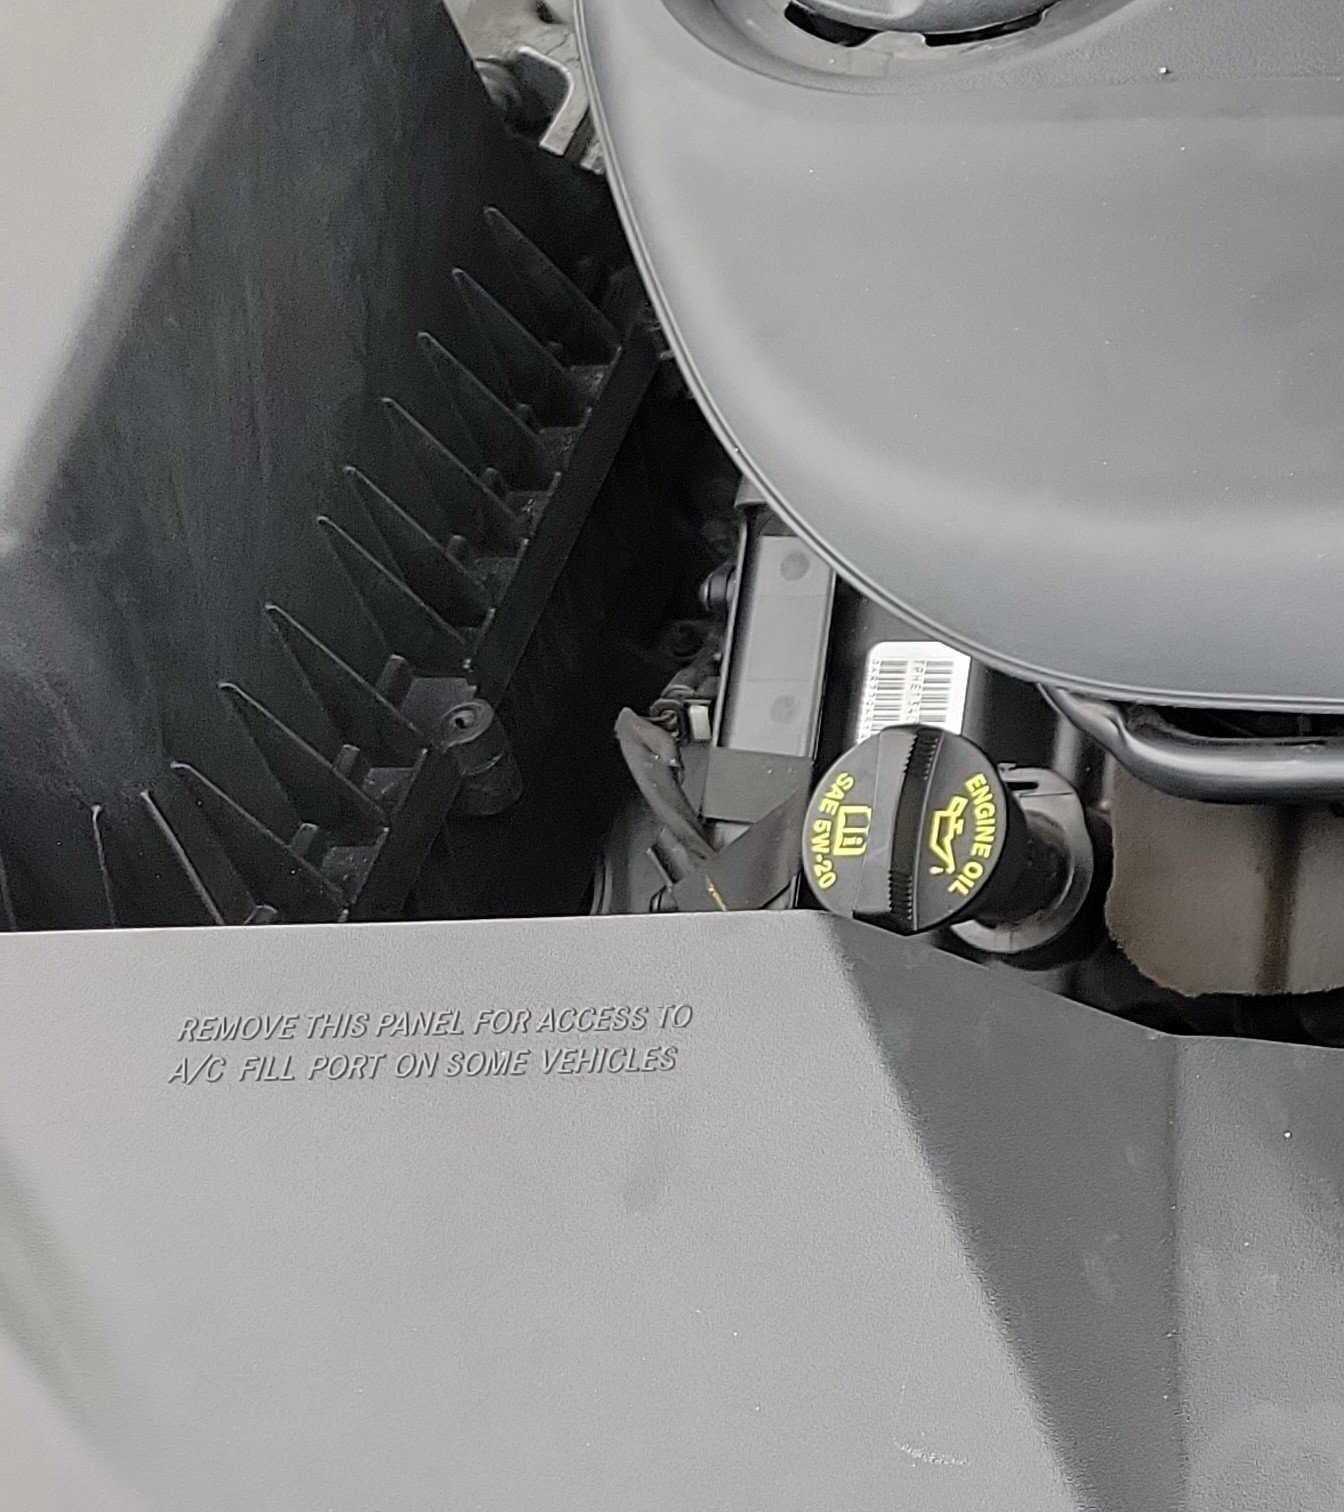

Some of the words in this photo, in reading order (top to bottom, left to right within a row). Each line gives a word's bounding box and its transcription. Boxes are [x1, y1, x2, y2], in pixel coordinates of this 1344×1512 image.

[819, 771, 855, 816] SAE
[964, 773, 996, 859] ENGINE
[810, 819, 837, 889] 5W-20
[948, 860, 985, 896] OIL
[177, 1014, 300, 1042] REMOVE
[306, 1012, 371, 1040] THIS
[375, 1008, 465, 1038] PANEL
[473, 1007, 531, 1037] FOR
[536, 1005, 650, 1034] ACCESS
[657, 1003, 694, 1031] TO
[168, 1053, 225, 1085] A/C
[238, 1054, 296, 1084] FILL
[307, 1052, 386, 1082] PORT
[395, 1050, 440, 1080] ON
[445, 1048, 531, 1078] SOME
[540, 1044, 680, 1076] VEHICLES
